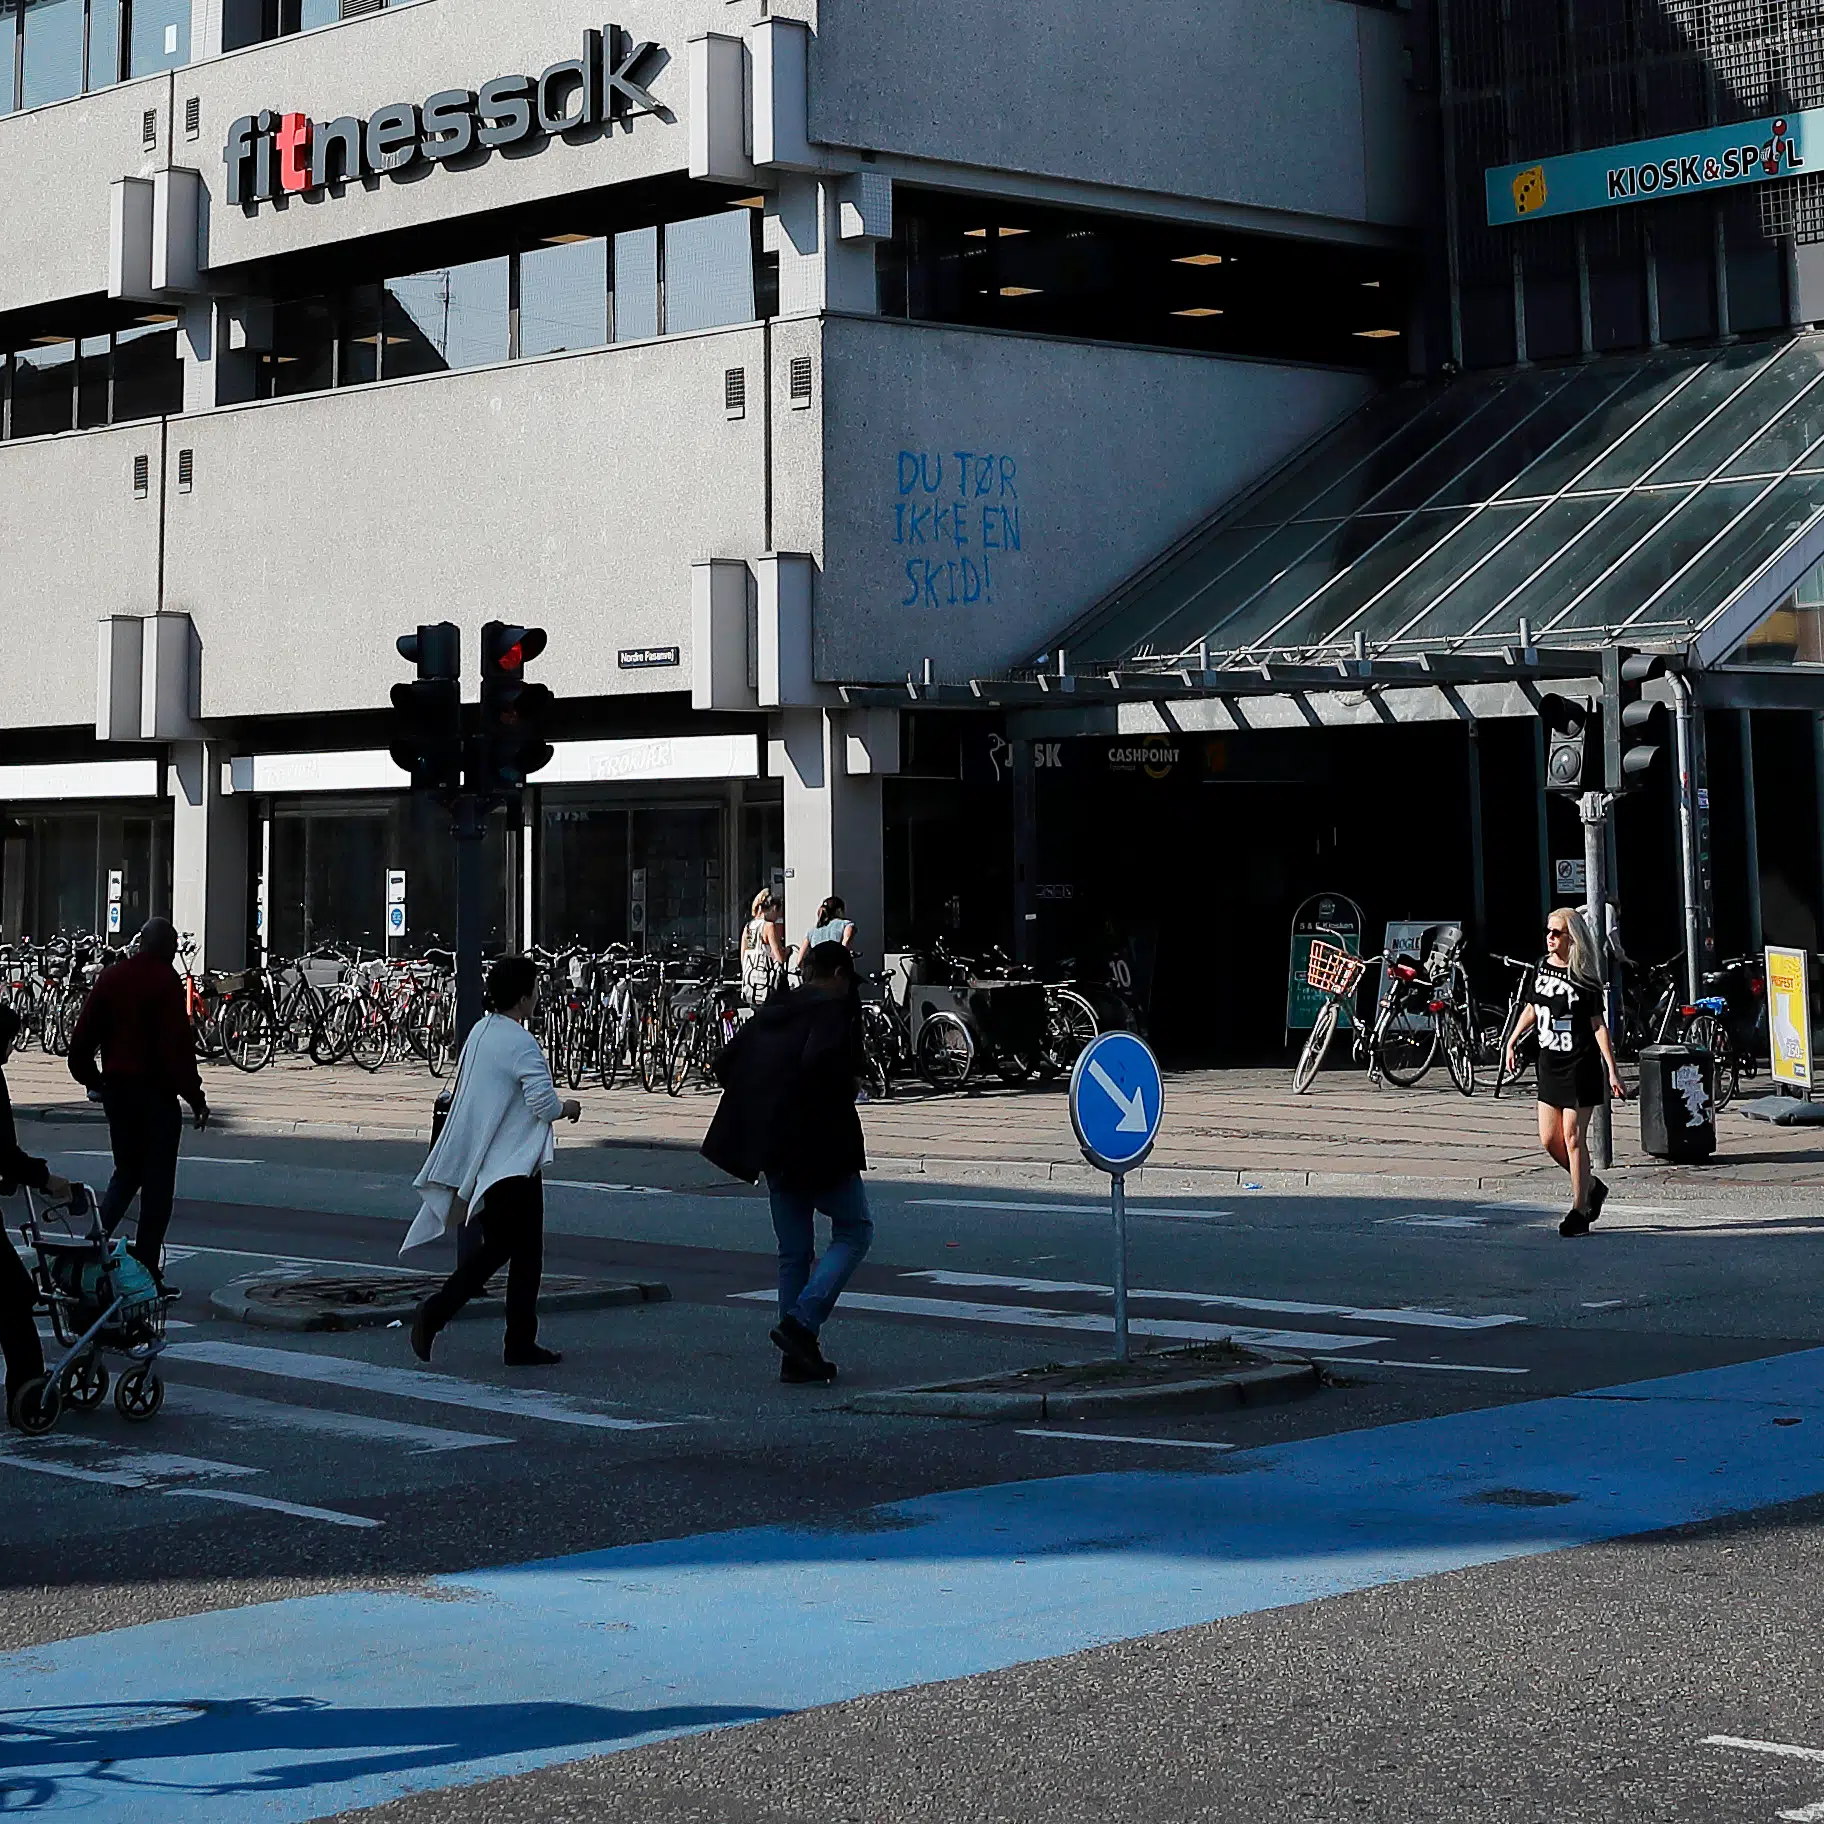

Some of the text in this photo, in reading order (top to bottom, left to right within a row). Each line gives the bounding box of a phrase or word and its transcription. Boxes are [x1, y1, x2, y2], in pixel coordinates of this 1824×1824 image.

[222, 23, 678, 206] fitnessdk
[897, 450, 1018, 498] DU TØR
[891, 499, 1021, 551] IKKE EN
[902, 555, 992, 608] SKID!
[1004, 743, 1064, 768] JSK
[1107, 747, 1180, 763] CASHPOINT
